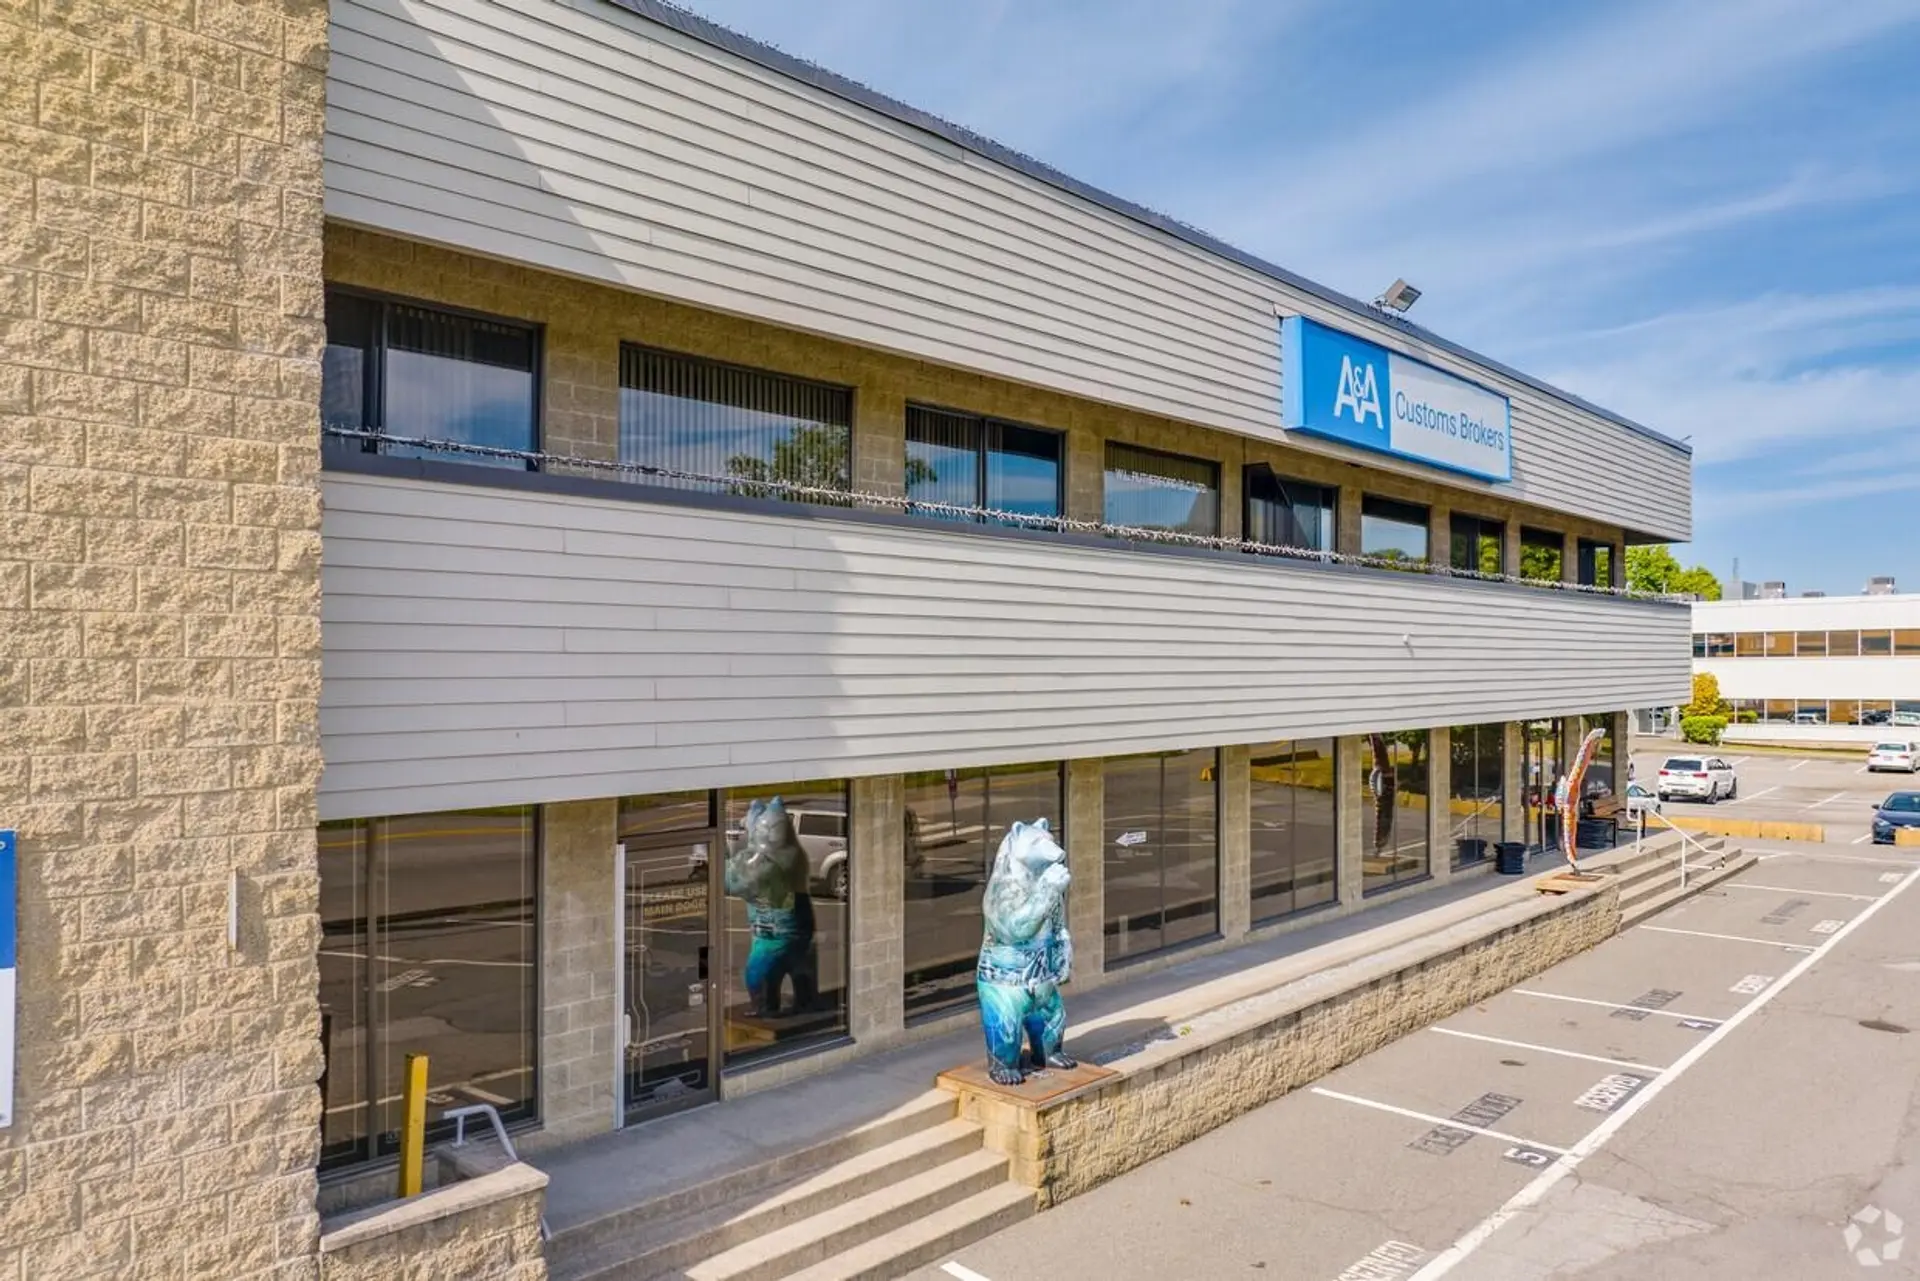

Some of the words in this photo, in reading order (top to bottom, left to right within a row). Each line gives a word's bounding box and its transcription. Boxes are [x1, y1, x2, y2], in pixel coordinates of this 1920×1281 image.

[1333, 355, 1384, 430] A&A
[1395, 391, 1456, 437] Customs
[1460, 412, 1505, 451] Brokers
[1505, 1147, 1548, 1165] 5
